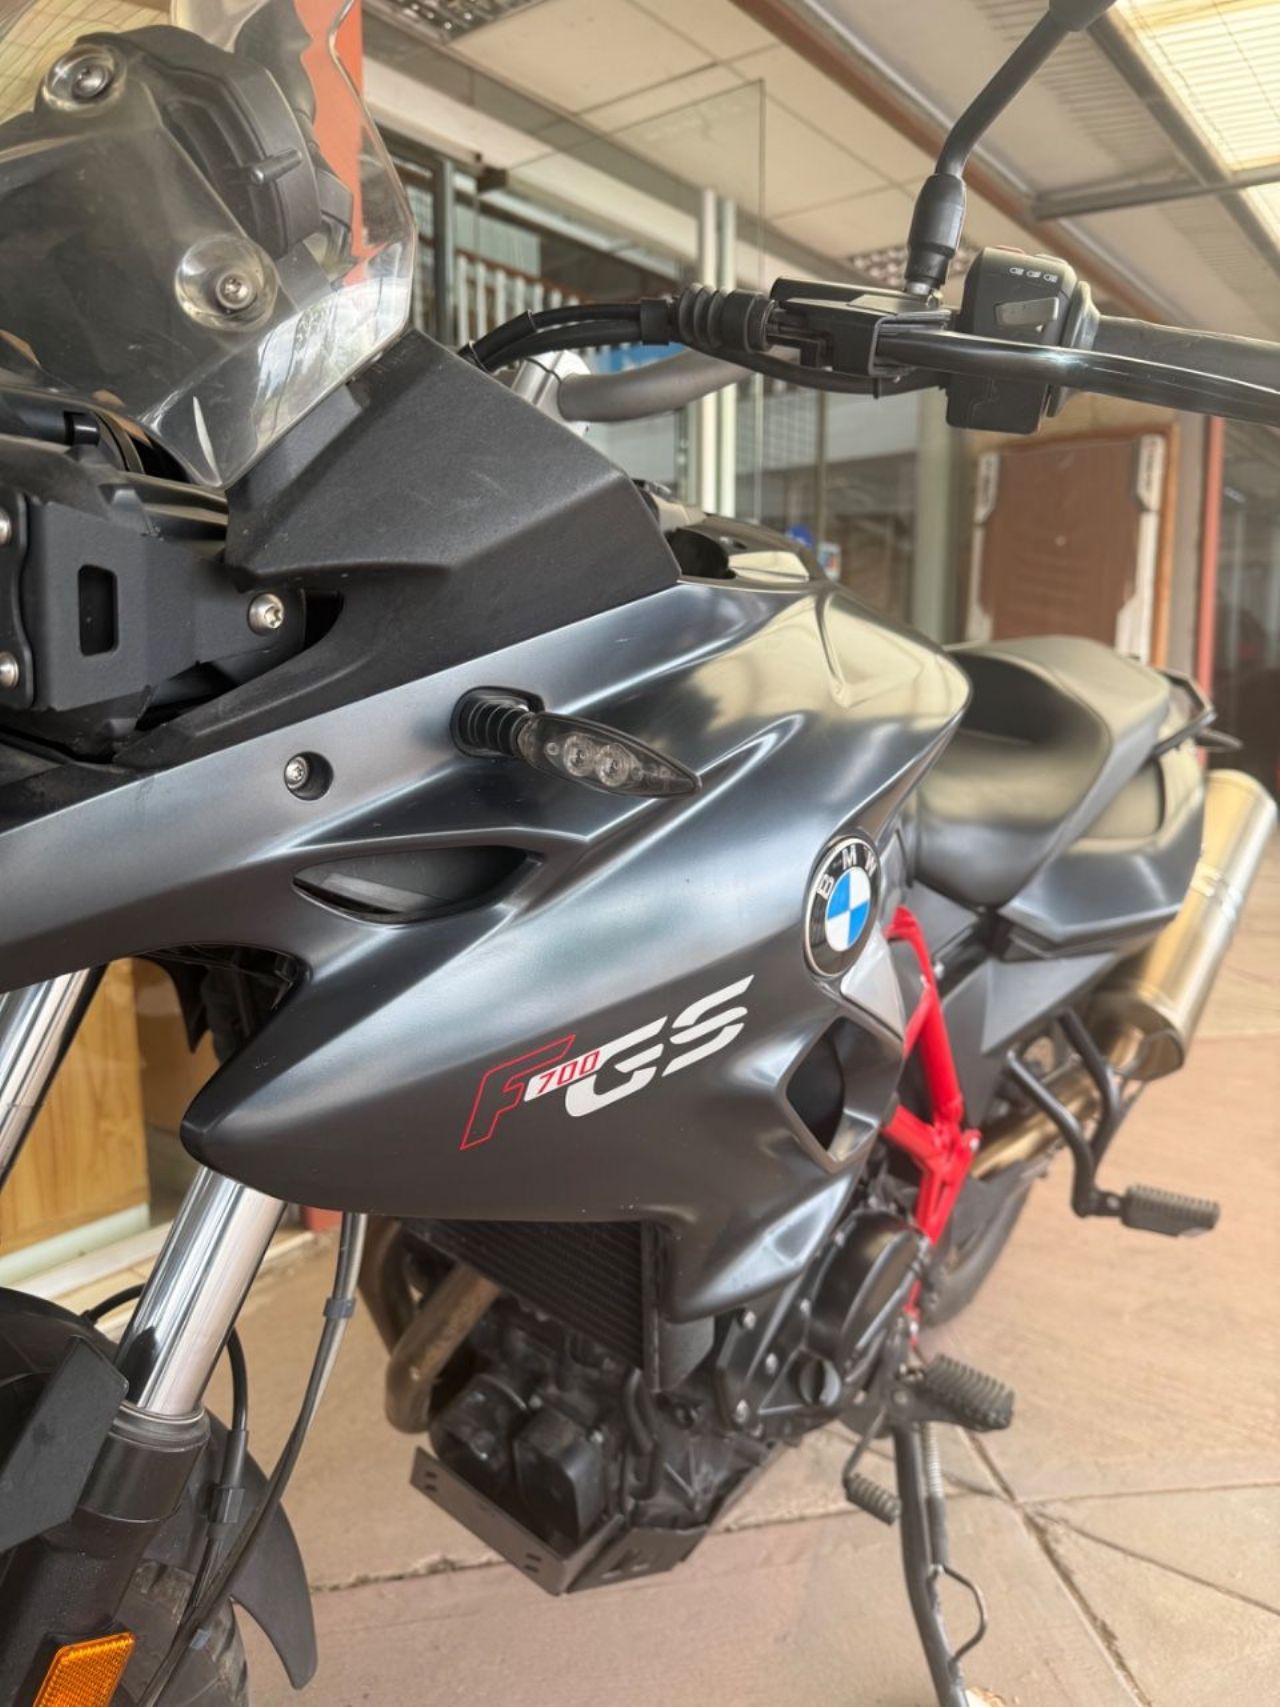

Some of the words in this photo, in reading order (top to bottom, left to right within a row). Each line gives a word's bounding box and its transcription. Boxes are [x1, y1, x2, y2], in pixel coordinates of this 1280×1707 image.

[816, 844, 877, 900] BMW
[537, 1050, 600, 1094] 700
[562, 974, 755, 1117] GS
[460, 1034, 576, 1150] F
